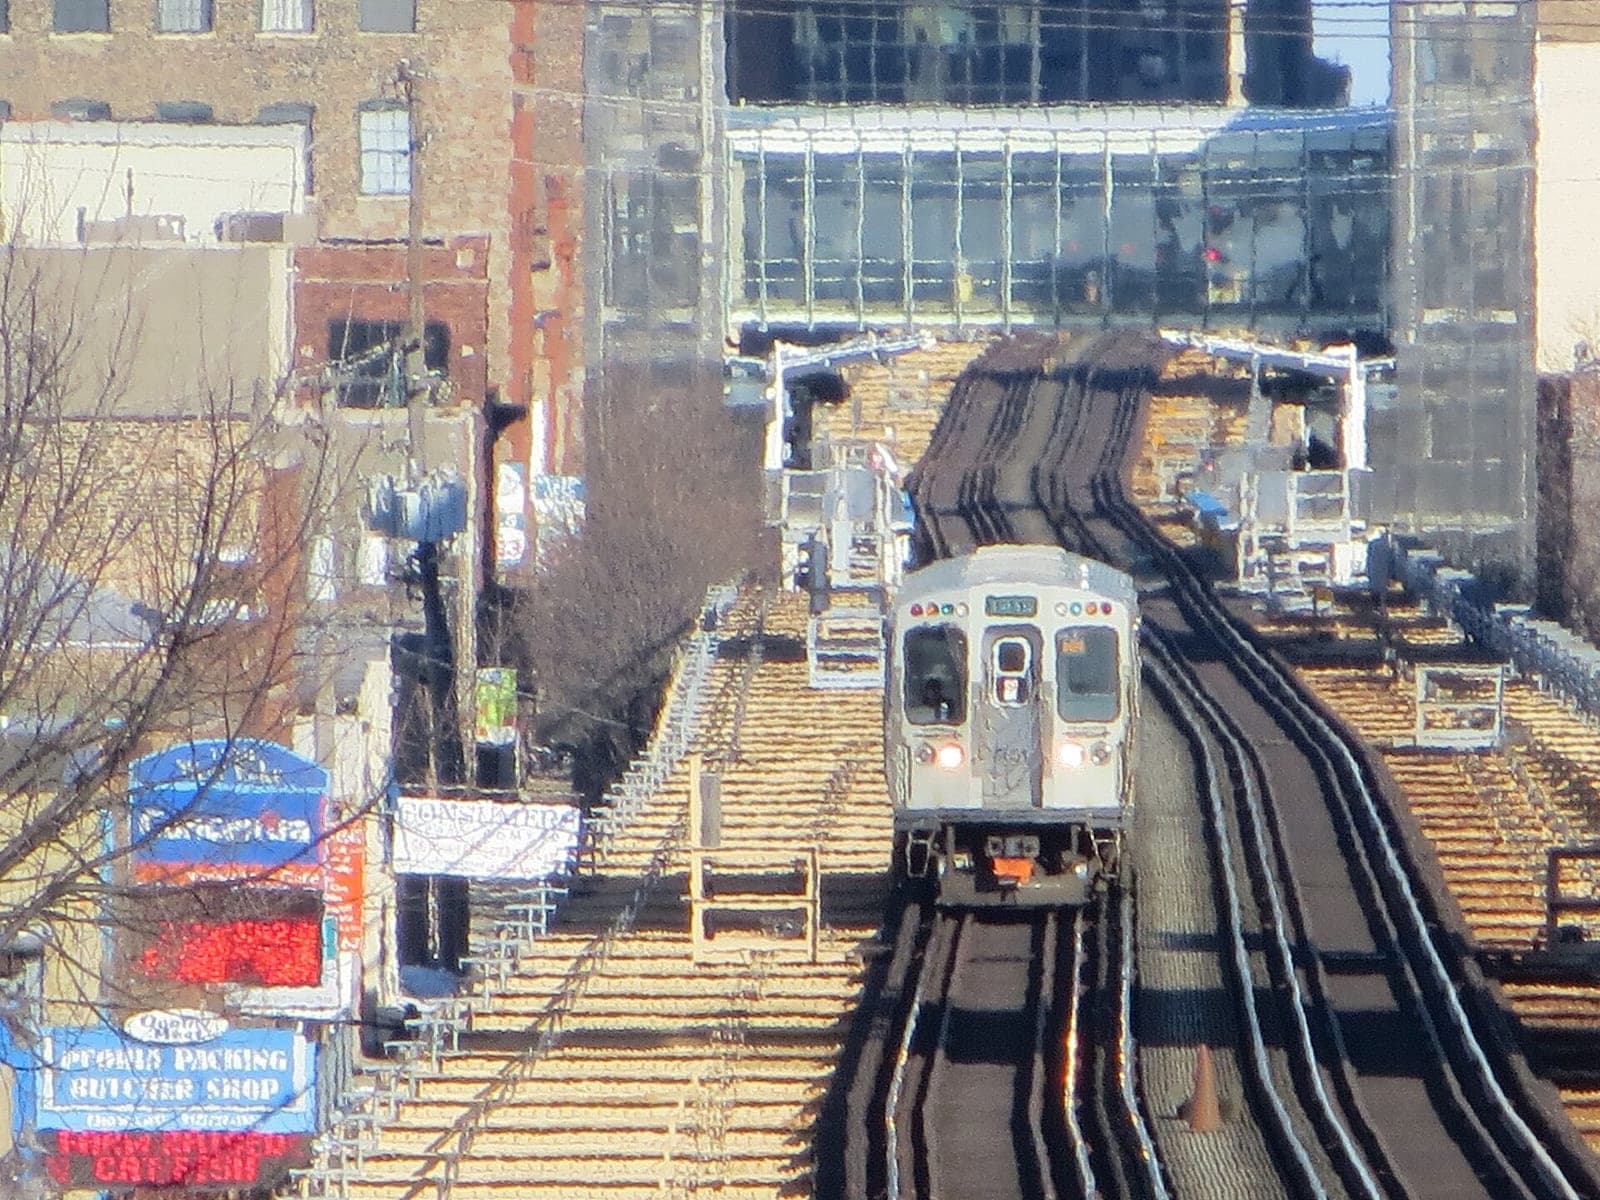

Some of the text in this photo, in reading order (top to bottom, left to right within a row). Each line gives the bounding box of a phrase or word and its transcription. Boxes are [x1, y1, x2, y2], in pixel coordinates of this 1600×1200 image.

[174, 1048, 288, 1072] PACKING
[69, 1077, 280, 1100] BUTCHER SHOP
